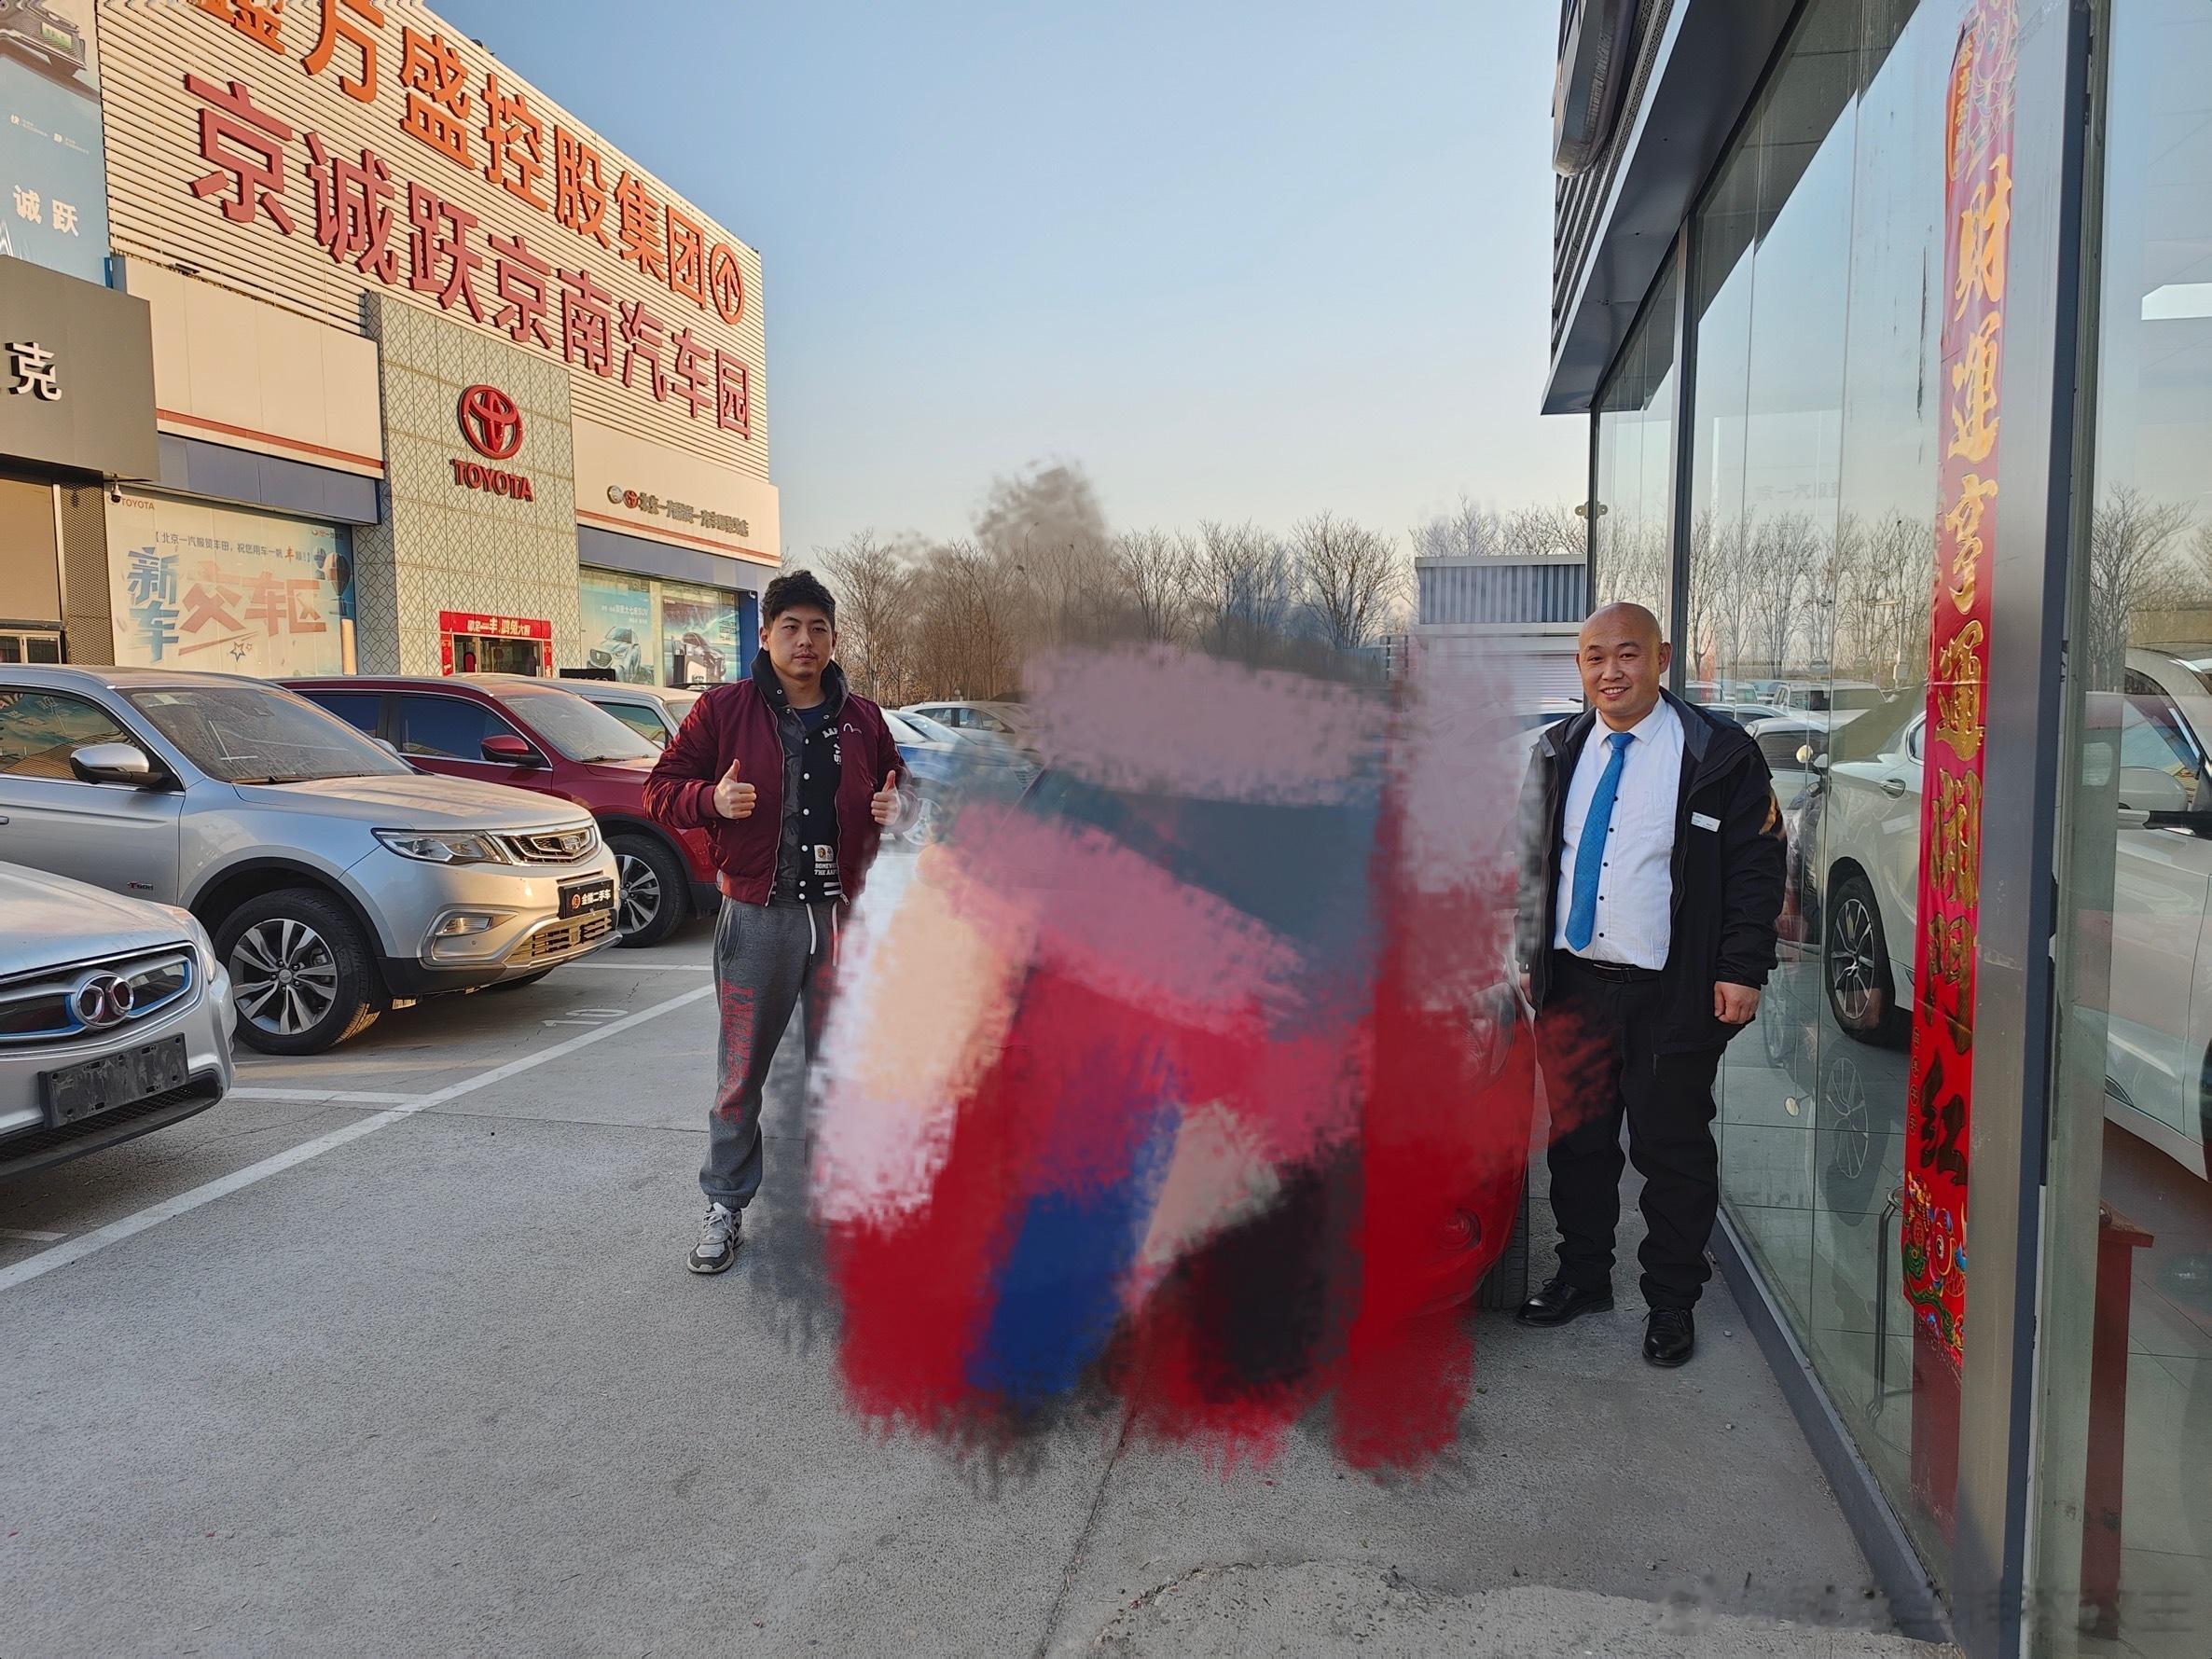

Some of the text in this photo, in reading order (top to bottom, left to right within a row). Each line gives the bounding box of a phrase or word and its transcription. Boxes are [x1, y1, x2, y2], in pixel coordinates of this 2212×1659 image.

[13, 185, 80, 237] 诚跃
[184, 74, 751, 440] 京诚跃京南汽车园
[6, 342, 62, 401] 克
[121, 498, 155, 510] TOYOTA
[449, 458, 533, 502] TOYOTA
[822, 727, 839, 738] AAP
